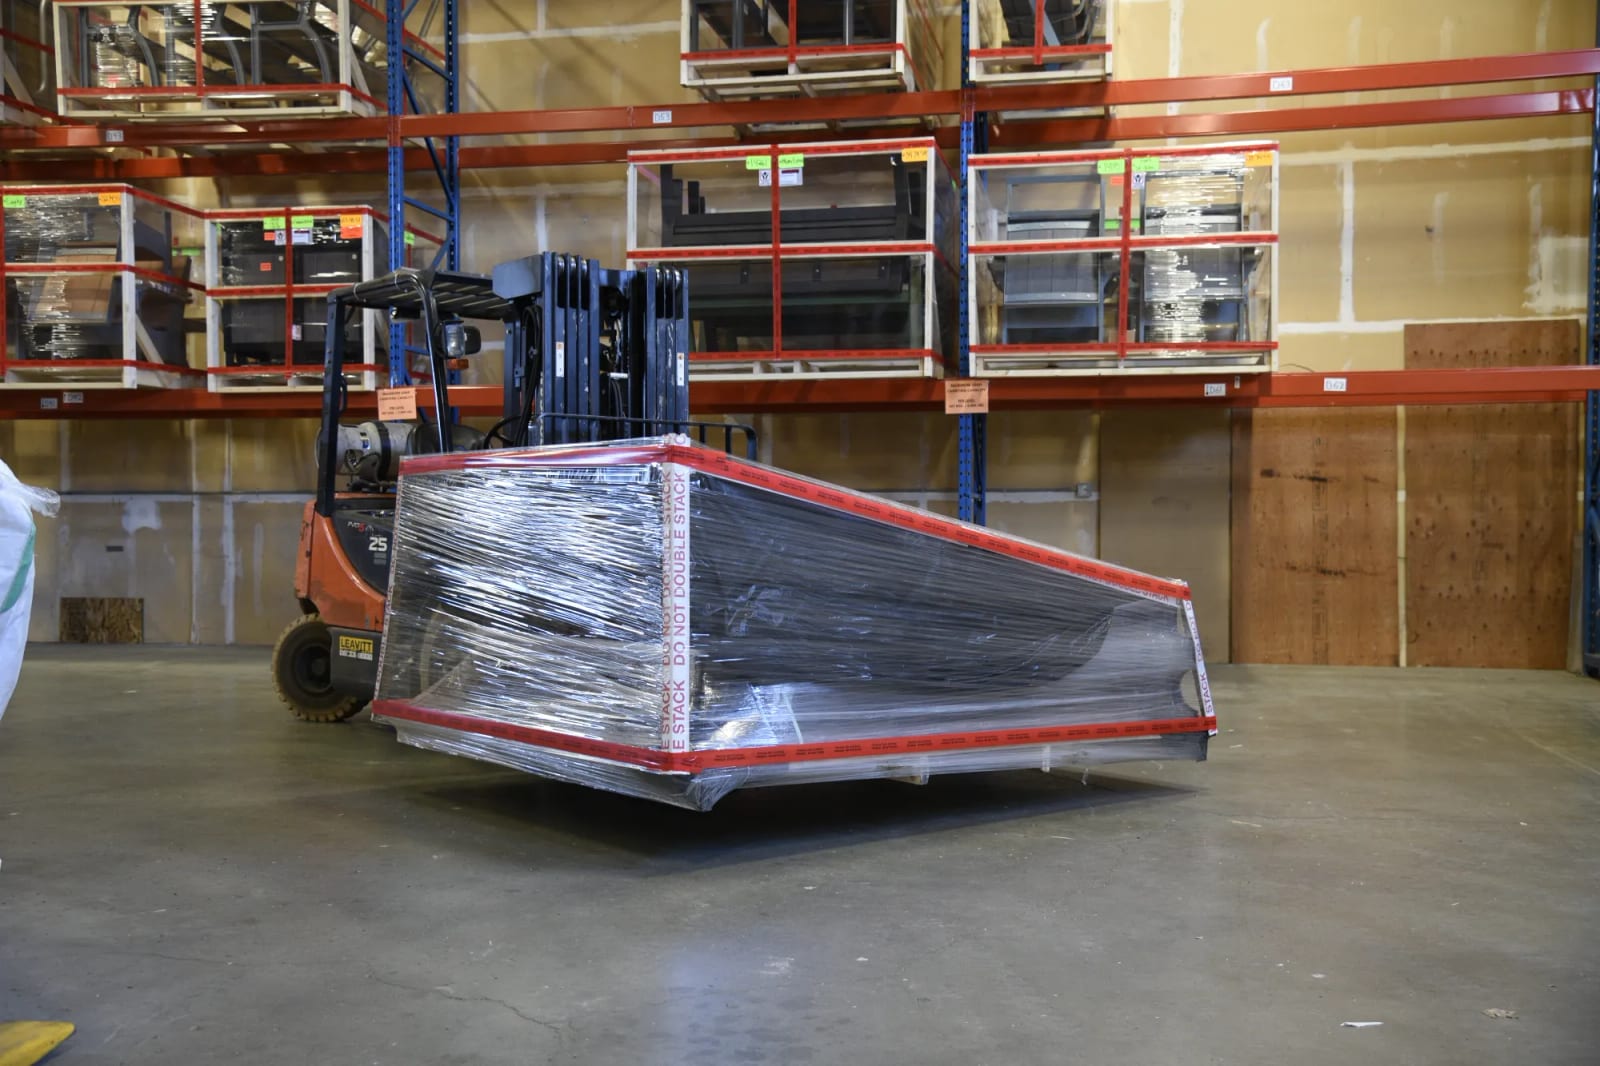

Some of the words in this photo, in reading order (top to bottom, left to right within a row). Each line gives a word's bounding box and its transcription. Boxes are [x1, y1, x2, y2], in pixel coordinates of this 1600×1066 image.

[674, 472, 686, 525] STACK
[368, 536, 388, 552] 25
[674, 529, 686, 598] DOUBLE
[674, 603, 686, 637] NOT
[340, 637, 372, 652] LEAVITT
[673, 641, 686, 666] DO
[673, 680, 685, 734] STACK
[1200, 672, 1213, 713] STACK
